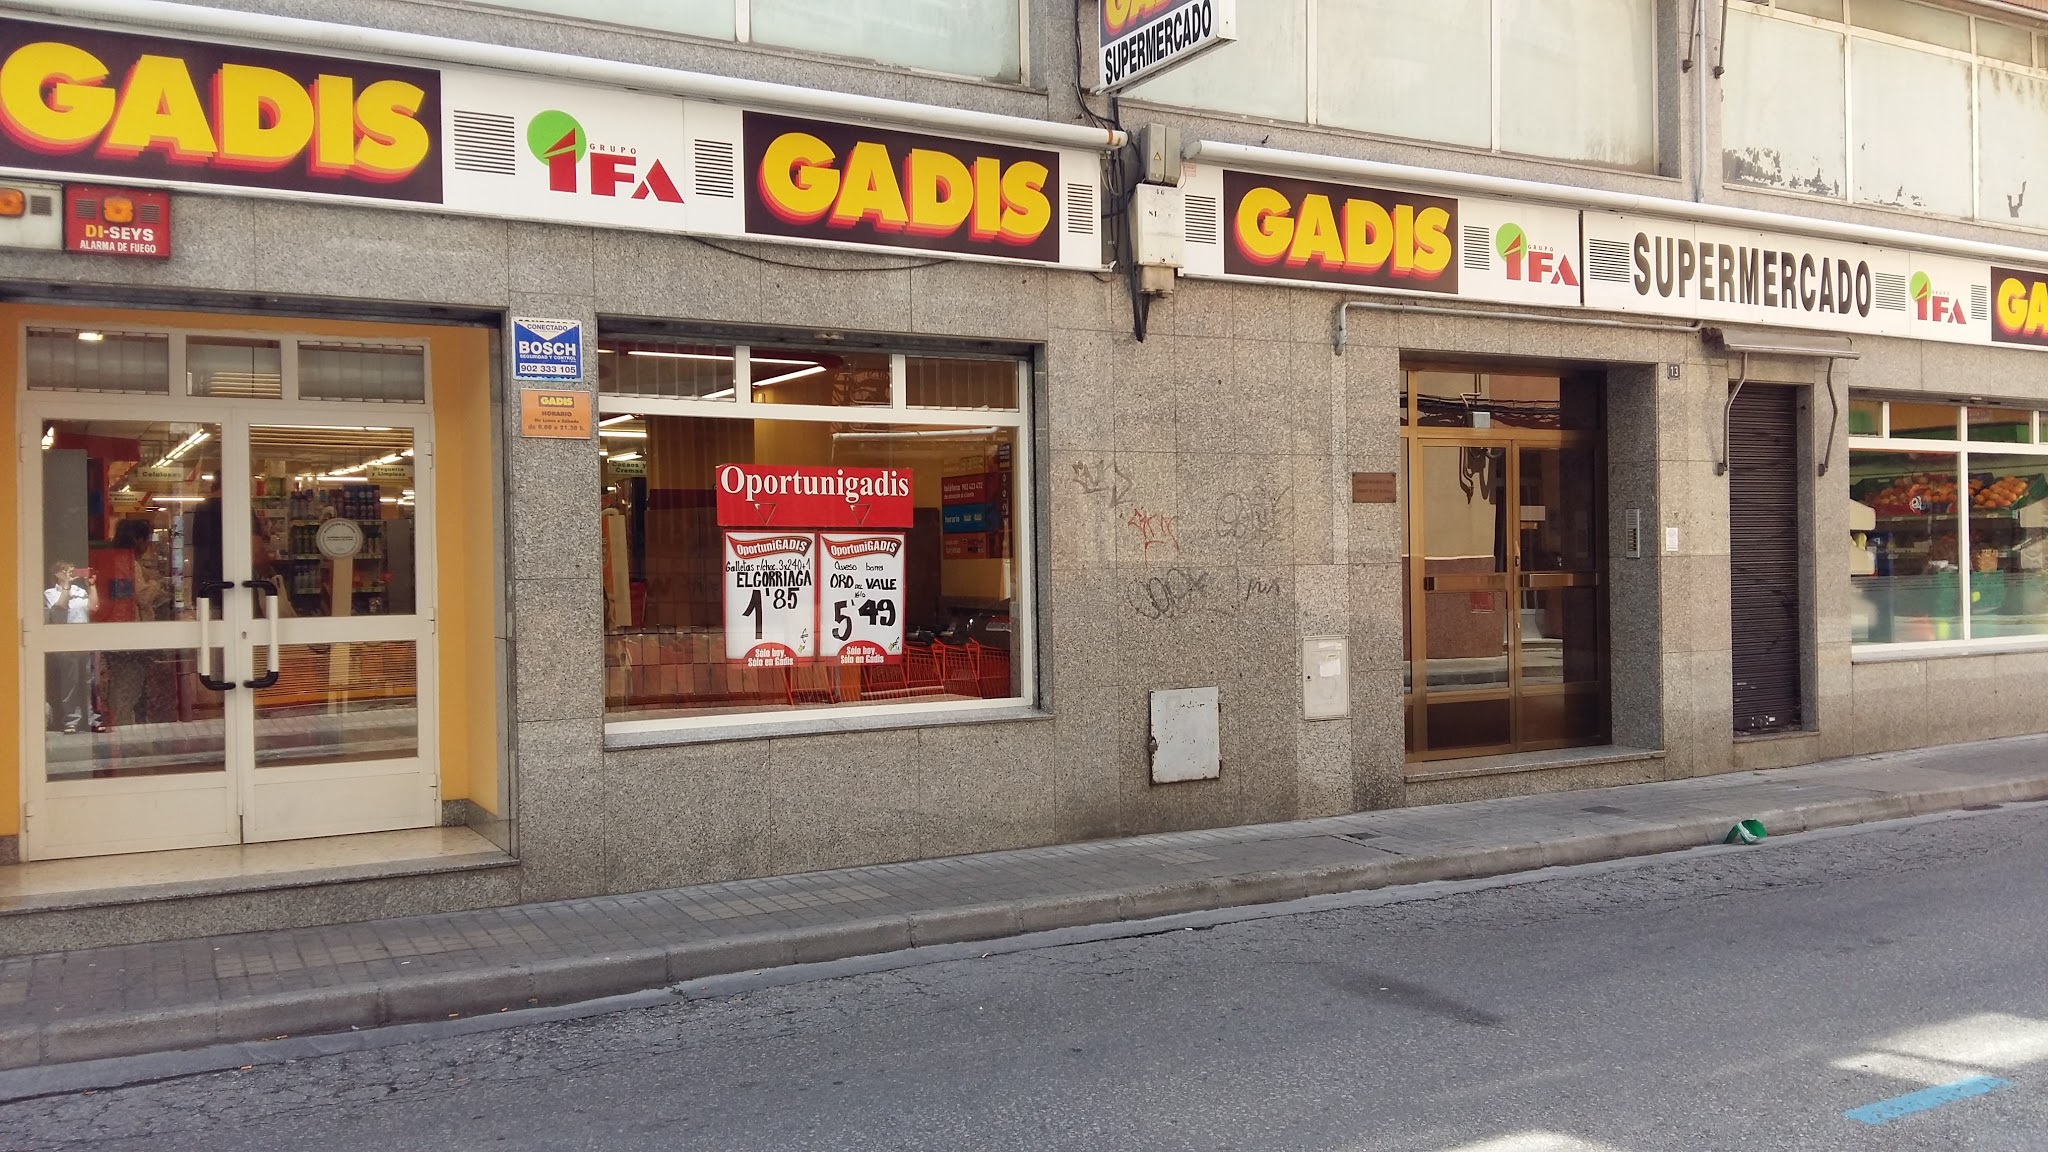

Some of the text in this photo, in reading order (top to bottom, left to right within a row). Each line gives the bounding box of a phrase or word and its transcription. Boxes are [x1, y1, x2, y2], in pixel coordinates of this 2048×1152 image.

[1105, 0, 1212, 85] SUPERMERCADO
[0, 41, 429, 184] GADIS
[589, 143, 637, 155] GRUPO
[759, 131, 1051, 246] GADIS
[85, 224, 154, 241] DI-SEYS
[1232, 186, 1452, 281] GADIS
[80, 240, 157, 254] ALARMA DE FUEGO
[1528, 244, 1554, 252] GRUPO
[1634, 232, 1871, 317] SUPERMERCADO
[527, 323, 568, 331] CONECTADO
[519, 341, 576, 355] BOSCH
[520, 364, 576, 374] 902 333 105
[1670, 366, 1679, 377] 13
[540, 396, 573, 405] GADIS
[720, 465, 910, 503] Oportunigadis
[736, 538, 808, 556] OportuniGADIS
[830, 540, 898, 556] OportuniGADIS
[725, 560, 755, 573] Galletas
[834, 560, 858, 571] Queso
[736, 569, 812, 588] ELGORRIAGA
[829, 573, 855, 589] ORO
[864, 578, 898, 591] VALLE
[764, 658, 774, 666] en
[774, 656, 795, 666] Gadis
[855, 655, 865, 663] en
[865, 654, 885, 664] Gadis
